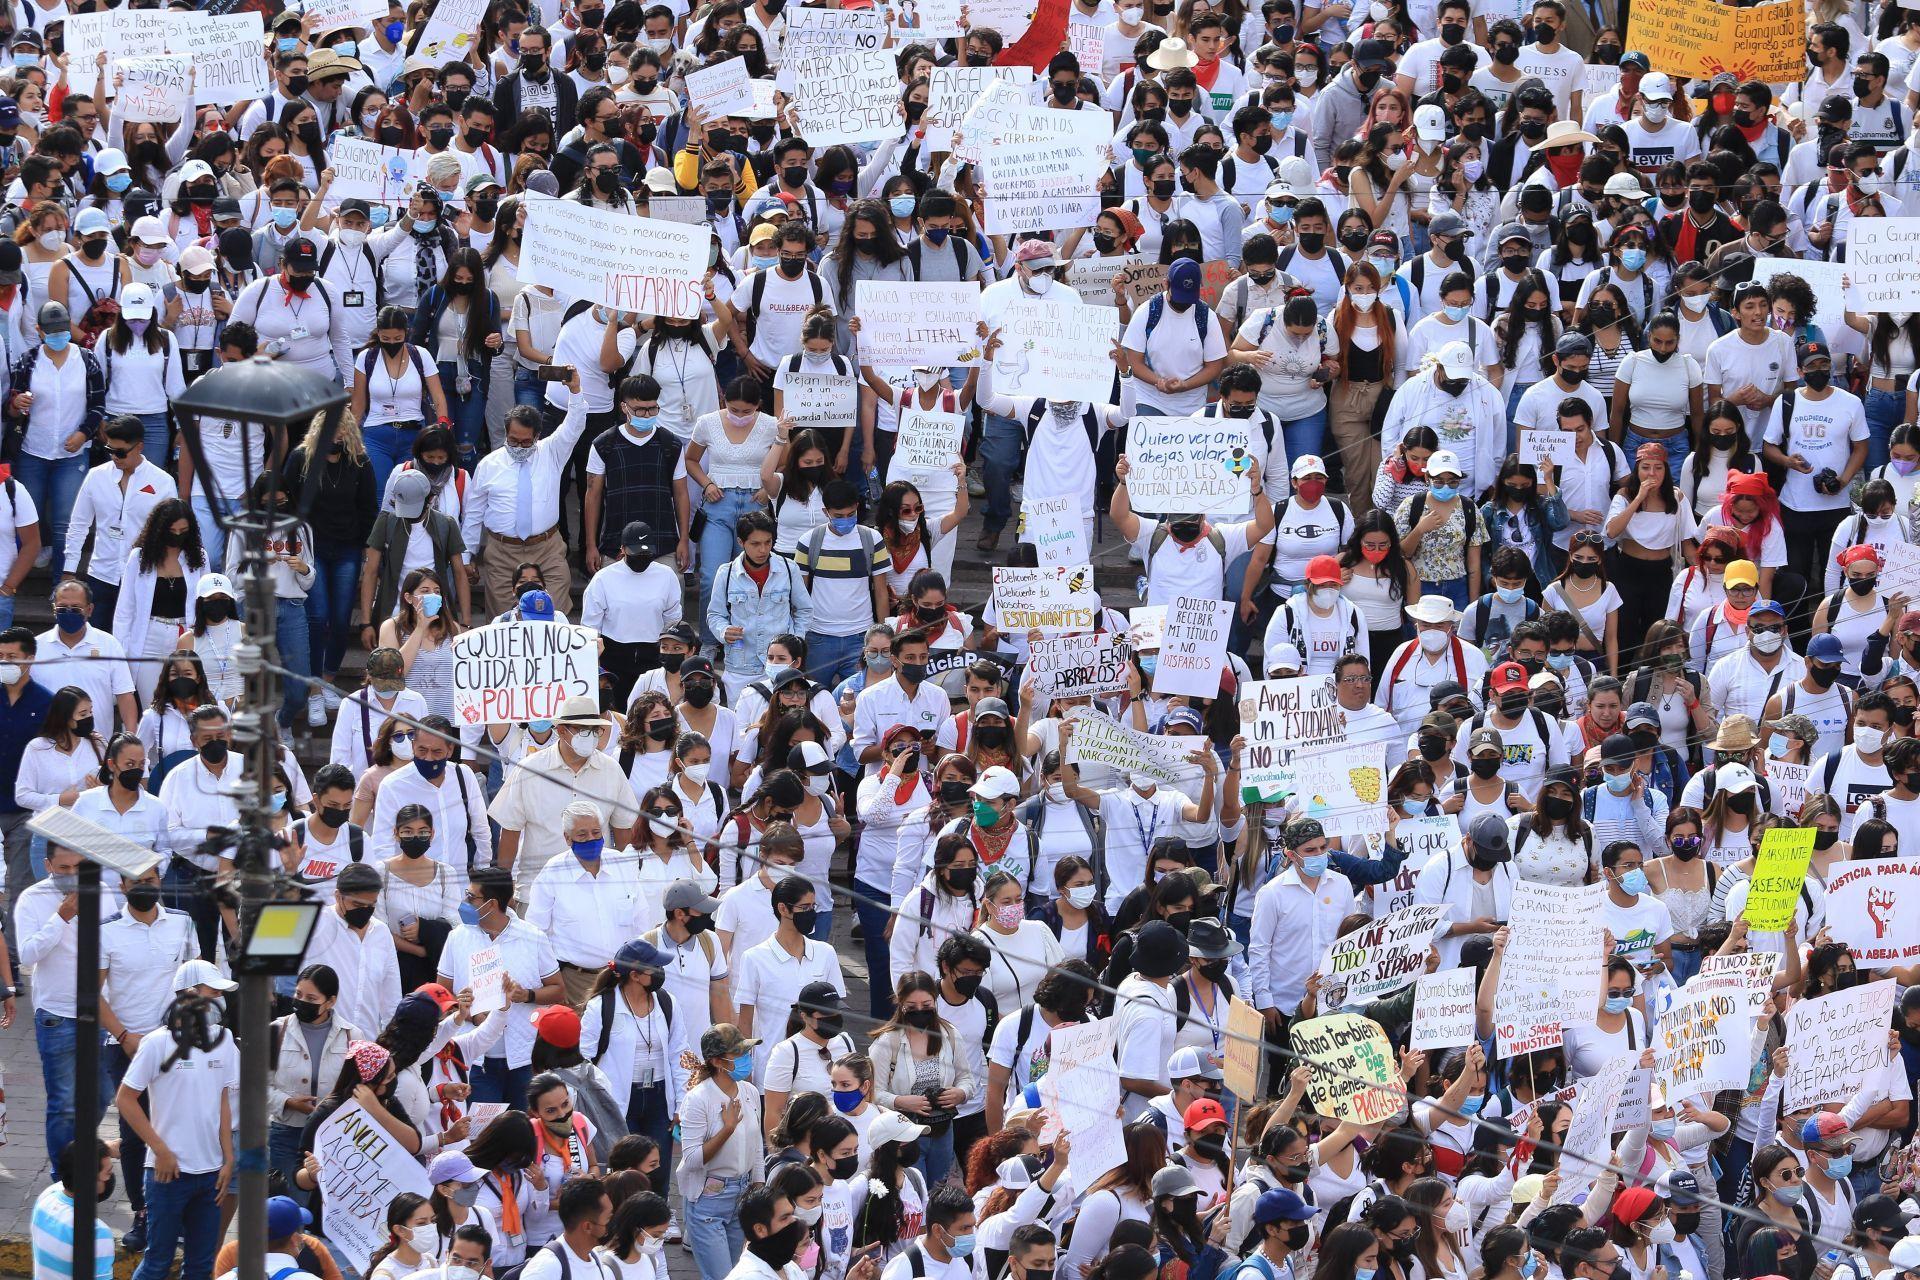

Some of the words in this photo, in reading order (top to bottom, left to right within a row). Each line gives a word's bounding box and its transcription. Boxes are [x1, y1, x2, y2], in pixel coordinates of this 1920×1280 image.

[789, 11, 813, 29] LA
[820, 12, 884, 29] GUARDIA
[1736, 9, 1750, 23] En
[1768, 5, 1793, 21] estado
[785, 30, 849, 46] NACIONAL
[855, 34, 876, 48] NO
[1735, 19, 1794, 42] Guanajuato
[237, 40, 262, 59] TODO
[1734, 40, 1779, 54] peligroso
[1782, 37, 1794, 49] ser
[794, 56, 832, 79] MATAR
[839, 55, 858, 74] NO
[864, 50, 886, 71] ES
[1769, 51, 1784, 62] que
[1523, 65, 1568, 77] GUESS
[144, 85, 167, 97] SIN
[794, 82, 812, 100] UN
[815, 75, 857, 97] DELITO
[859, 75, 898, 92] CUANDO
[124, 94, 175, 116] MIEDO
[809, 92, 863, 116] ASESINO
[801, 117, 824, 134] PARA
[826, 120, 837, 130] EL
[840, 105, 905, 134] ESTADO
[1004, 154, 1021, 165] UNA
[992, 167, 1017, 180] GRITA
[1019, 166, 1030, 176] LA
[1031, 163, 1070, 175] COLMENA
[993, 179, 1036, 191] QUEREMOS
[997, 209, 1007, 220] LA
[1010, 206, 1044, 218] VERDAD
[1047, 204, 1058, 215] OS
[1061, 202, 1083, 214] HARA
[1012, 218, 1044, 230] SUDAR
[613, 223, 627, 235] los
[634, 227, 689, 244] mexicanos
[1854, 227, 1877, 245] La
[661, 267, 688, 276] arma
[1092, 264, 1121, 273] colmena
[1854, 270, 1877, 285] La
[605, 272, 702, 320] MATARNOS
[1046, 304, 1060, 318] NO
[905, 328, 968, 343] LITERAL
[785, 373, 820, 387] Dejan
[824, 374, 851, 387] libre
[824, 408, 856, 421] Nacional
[910, 416, 939, 431] Ahora
[941, 423, 954, 431] no
[901, 434, 917, 447] NOS
[919, 435, 946, 450] FALTAN
[1134, 421, 1184, 446] Quiero
[1189, 432, 1209, 445] ver
[1226, 431, 1249, 445] mis
[911, 454, 944, 466] ANGEL
[1139, 448, 1185, 468] abejas
[1190, 445, 1227, 463] volar,
[1129, 466, 1146, 480] NO
[1152, 465, 1189, 480] COMO
[1194, 463, 1218, 480] LES
[1176, 481, 1197, 495] LAS
[1199, 479, 1236, 496] ALAS
[1032, 499, 1068, 516] VENGO
[1045, 551, 1058, 561] NO
[996, 601, 1036, 611] Nosotros
[1176, 596, 1217, 612] QUIERO
[1002, 608, 1093, 628] ESTUDIANTES
[1176, 612, 1213, 626] RECIBIR
[1167, 624, 1180, 638] MI
[455, 623, 534, 660] ¿QUIÉN
[543, 624, 587, 657] NOS
[1029, 639, 1061, 654] ¡OYE
[1063, 634, 1099, 651] AMLO!
[1180, 642, 1196, 654] NO
[1067, 650, 1095, 667] NO
[1100, 645, 1132, 664] ERAN
[1162, 654, 1211, 670] DISPAROS
[454, 659, 518, 690] CUIDA
[525, 657, 542, 685] DE
[551, 654, 578, 682] LA
[1258, 684, 1301, 718] Angel
[1175, 711, 1199, 723] adidas
[1253, 720, 1275, 741] un
[1250, 746, 1272, 769] NO
[1419, 831, 1448, 855] que
[1765, 829, 1808, 843] GUARDIA
[304, 860, 337, 879] NIKE
[1750, 877, 1801, 893] ASESINA
[1828, 866, 1872, 895] JUSTICIA
[1877, 863, 1907, 876] PARA
[1413, 906, 1439, 918] que
[1512, 900, 1569, 914] GRANDE
[1331, 939, 1355, 955] nos
[1358, 925, 1388, 949] UNE
[1396, 916, 1439, 940] contra
[1331, 949, 1366, 973] TODO
[1714, 953, 1748, 971] MUNDO
[1750, 953, 1762, 966] SE
[1764, 953, 1777, 964] HA
[1866, 948, 1899, 959] ABEJA
[1345, 969, 1370, 985] nos
[1416, 1008, 1426, 1020] No
[1712, 996, 1736, 1016] NOS
[1794, 1010, 1812, 1037] No
[1818, 1001, 1836, 1024] fue
[1842, 1002, 1854, 1018] un
[1497, 1024, 1515, 1040] NO
[1528, 1022, 1562, 1037] SANGRE
[1290, 1029, 1331, 1057] Ahora
[1510, 1033, 1562, 1054] INJUSTICIA
[1337, 1054, 1357, 1072] que
[1354, 1041, 1373, 1059] CUI
[1310, 1086, 1327, 1104] de
[1333, 1102, 1349, 1118] me
